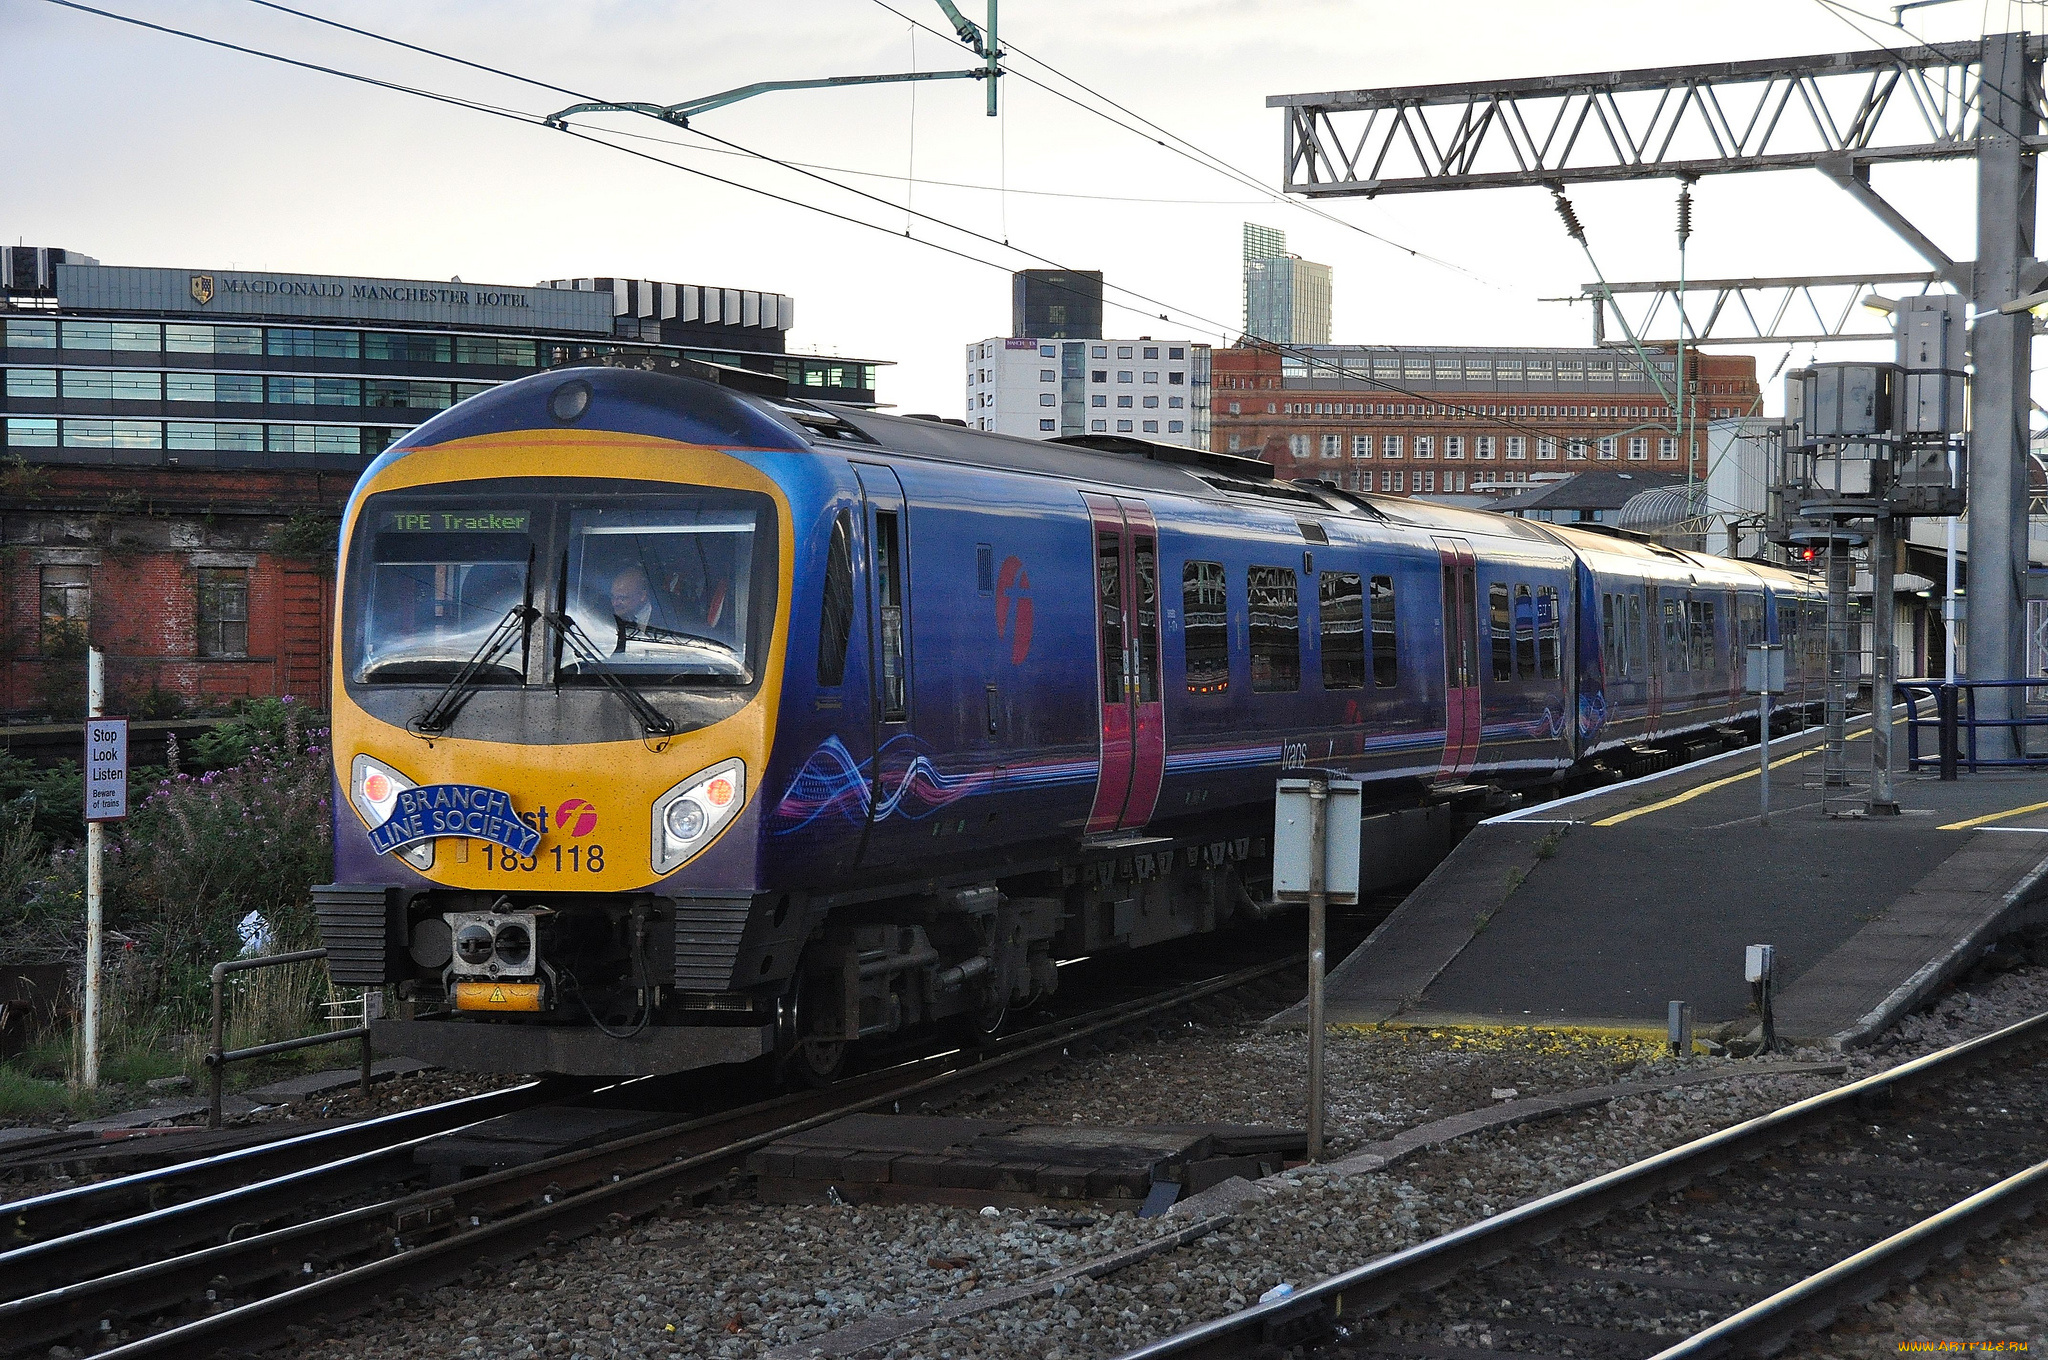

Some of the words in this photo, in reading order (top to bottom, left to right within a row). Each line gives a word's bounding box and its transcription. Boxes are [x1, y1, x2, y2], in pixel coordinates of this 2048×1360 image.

[221, 279, 344, 298] MACDONALD
[352, 284, 469, 304] MANCHESTER
[475, 291, 529, 308] HOTEL
[394, 514, 431, 530] TPE
[441, 514, 525, 530] Tracker
[93, 729, 117, 743] Stop
[93, 748, 118, 761] Look
[93, 768, 123, 781] Listen
[93, 789, 115, 798] Beware
[102, 800, 119, 808] trains
[400, 787, 507, 816] BRANCH
[372, 814, 425, 849] LINE
[433, 811, 537, 850] SOCIETY
[481, 844, 538, 872] 185
[550, 844, 605, 873] 118
